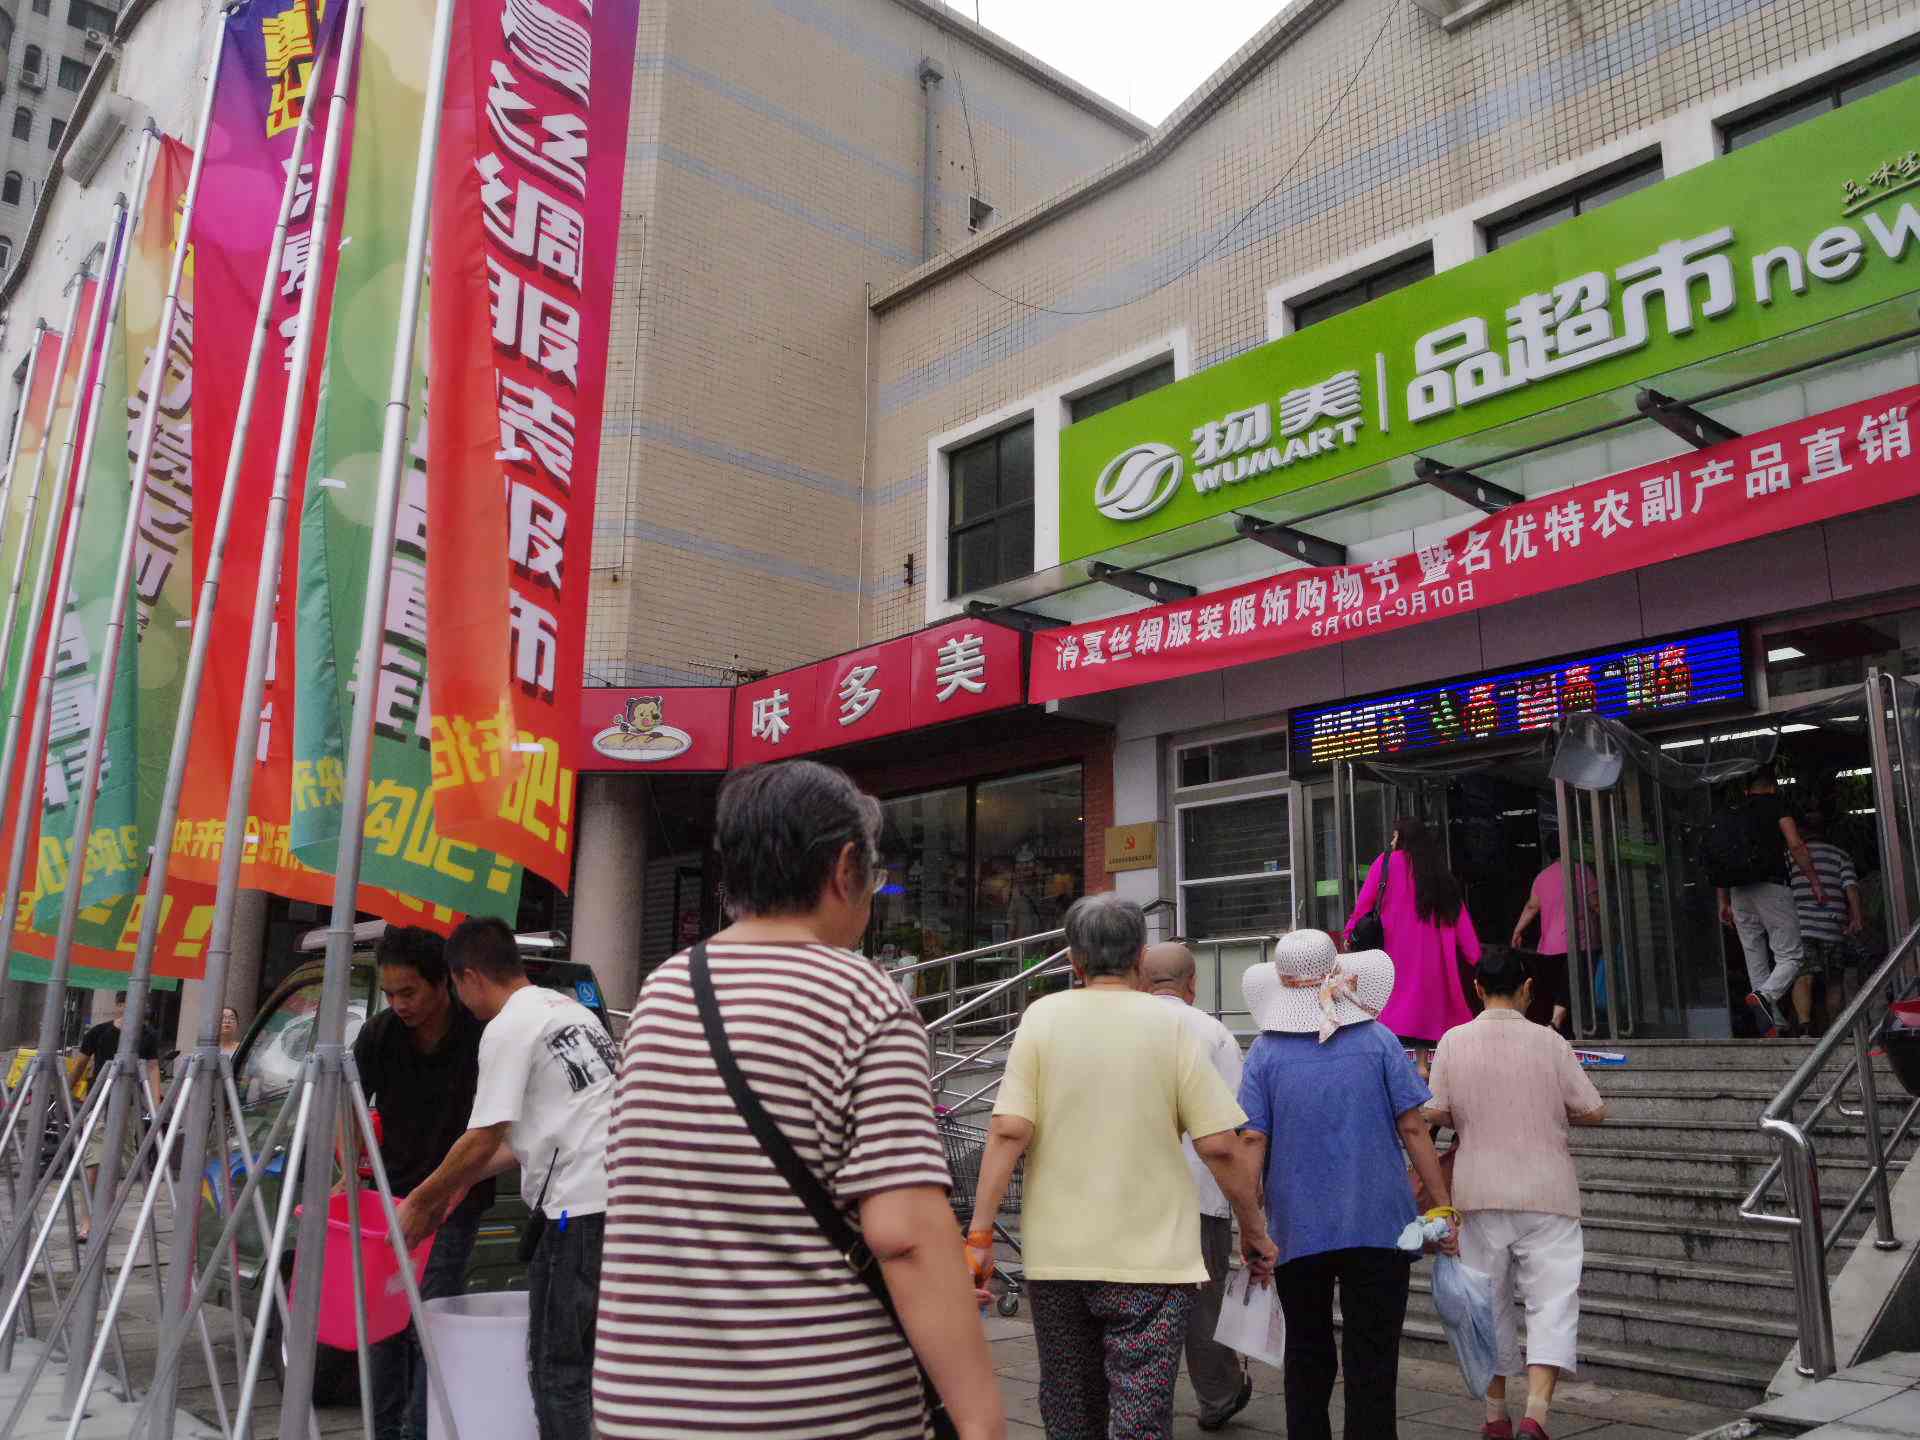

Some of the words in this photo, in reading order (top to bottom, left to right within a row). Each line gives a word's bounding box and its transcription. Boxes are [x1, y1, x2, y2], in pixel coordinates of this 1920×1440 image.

[1191, 371, 1362, 467] 物美
[1407, 226, 1736, 423] 品超市
[1191, 416, 1365, 494] WUMART
[751, 633, 987, 745] 味多美
